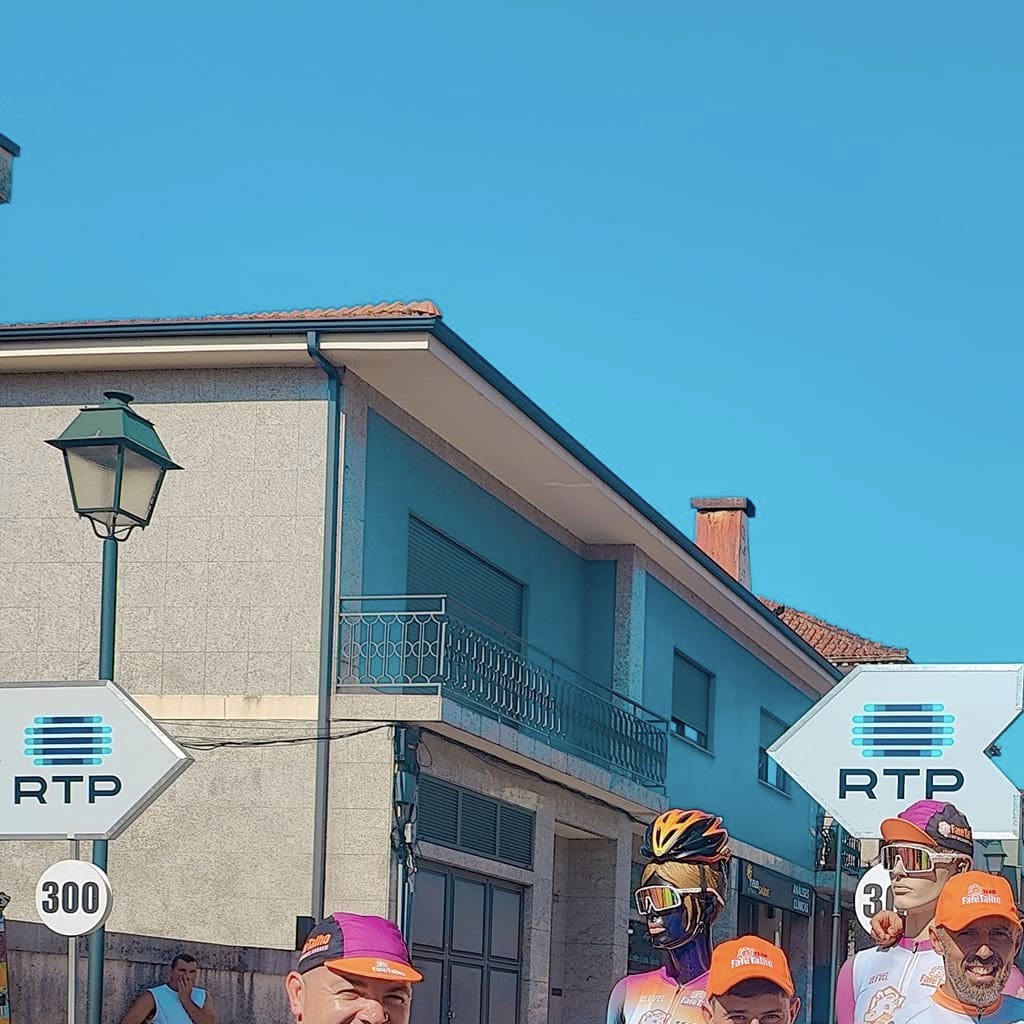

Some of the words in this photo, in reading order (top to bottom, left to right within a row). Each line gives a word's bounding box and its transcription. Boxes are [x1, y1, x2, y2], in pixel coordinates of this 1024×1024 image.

[14, 775, 122, 805] RTP
[838, 769, 965, 800] RTP
[42, 881, 100, 914] 300
